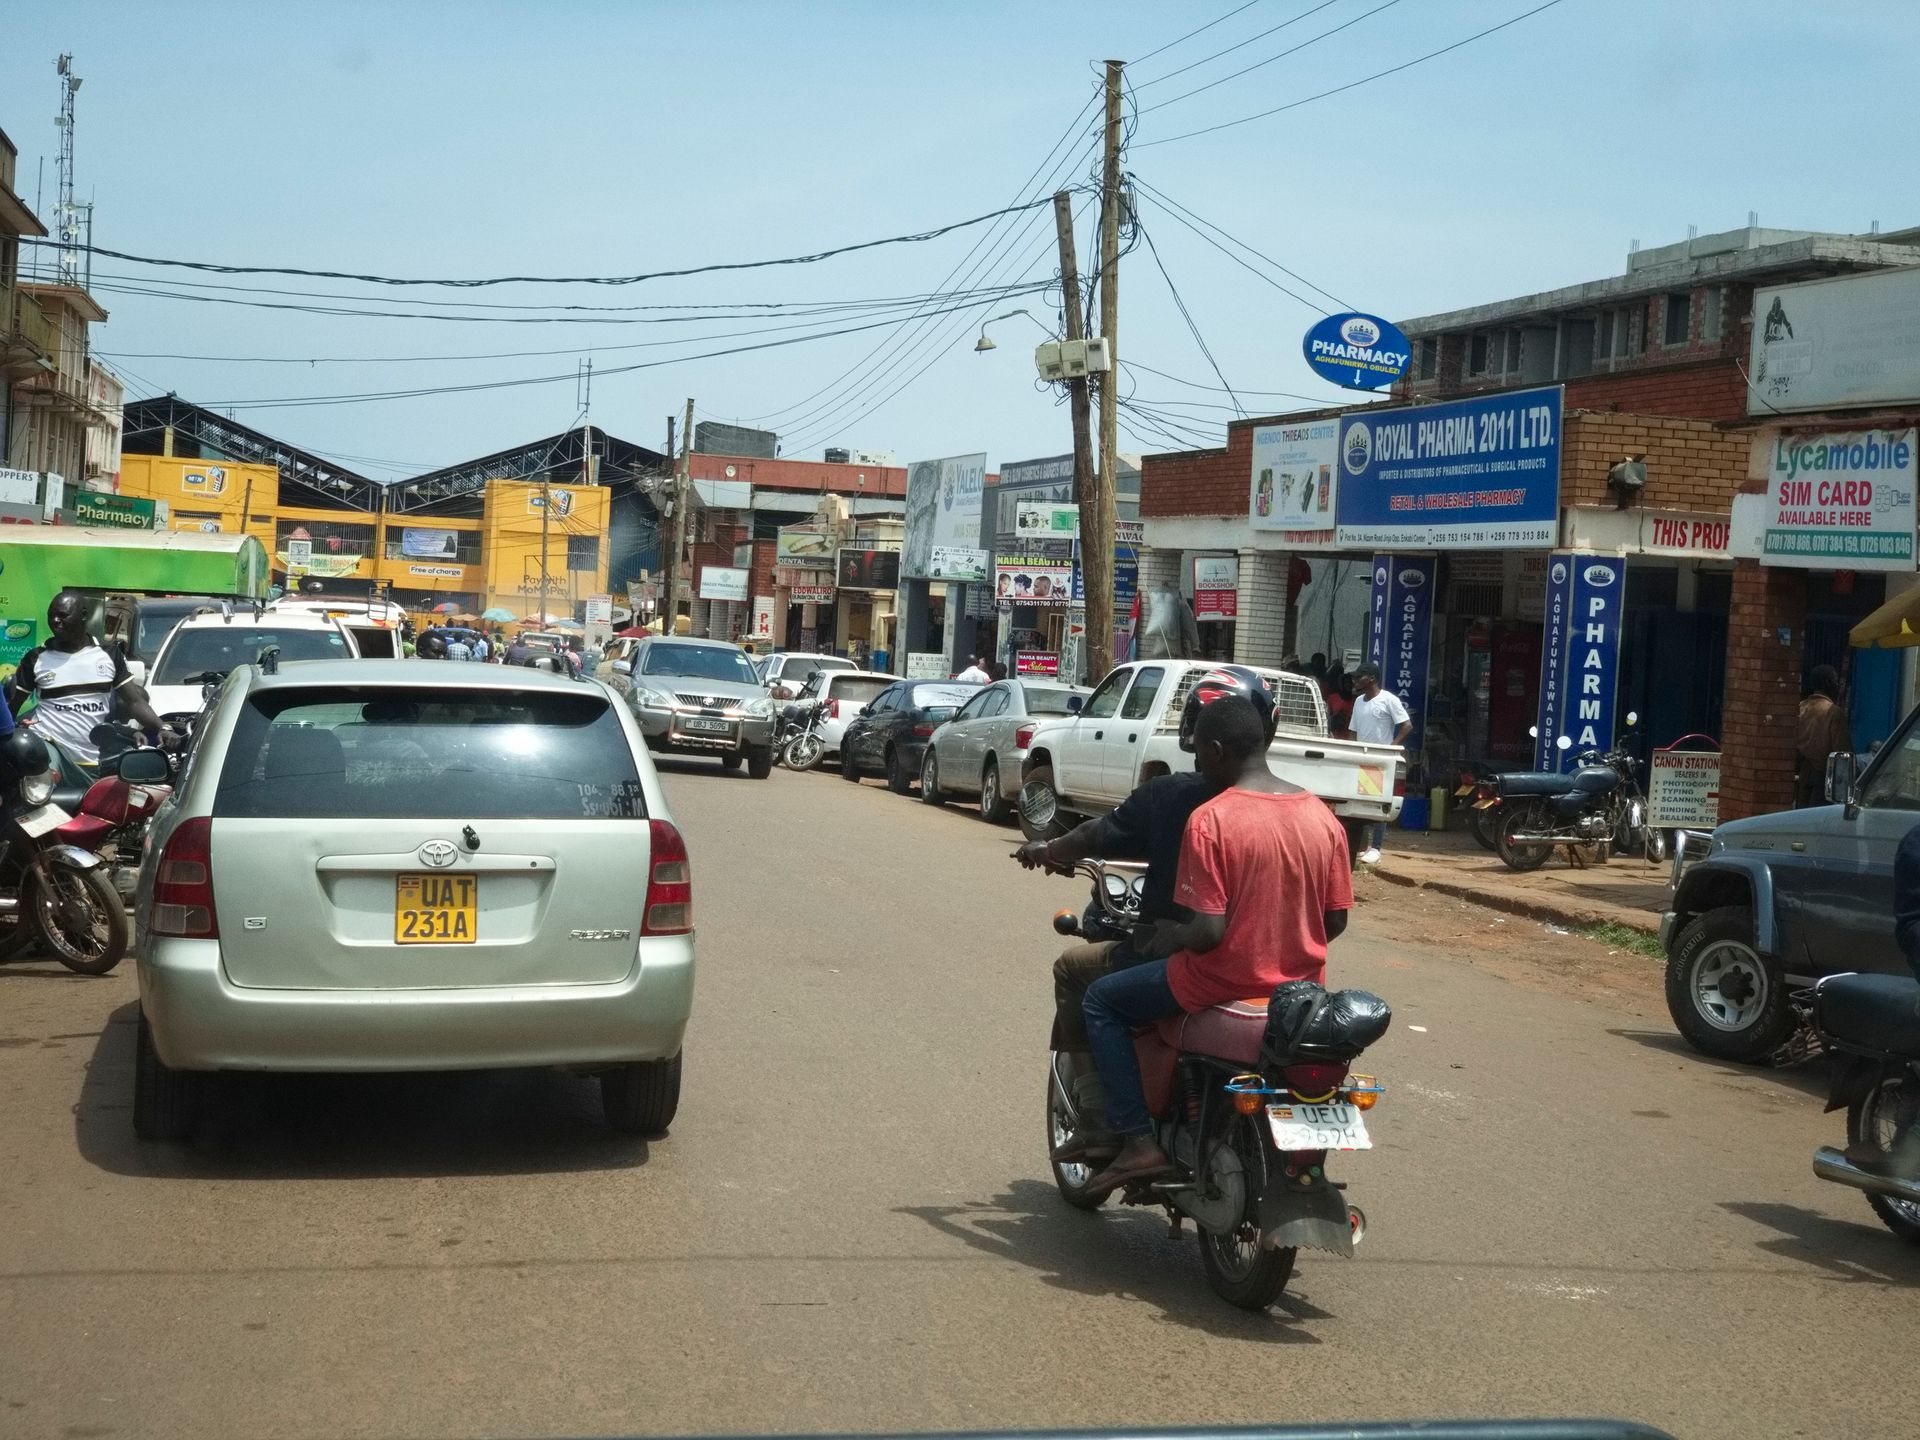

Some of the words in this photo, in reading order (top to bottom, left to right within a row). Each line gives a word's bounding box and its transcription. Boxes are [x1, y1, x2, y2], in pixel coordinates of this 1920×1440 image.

[1311, 339, 1408, 368] PHARMACY
[1314, 354, 1368, 370] AGHAFUNIRWA
[1369, 363, 1401, 375] OBULEZI
[1282, 427, 1309, 443] THREADS
[1310, 425, 1335, 440] CENTRE
[1375, 422, 1414, 462] ROYAL
[1417, 415, 1475, 459] PHARMA
[1478, 409, 1515, 453] 2011
[1519, 405, 1554, 449] LTD.
[1775, 434, 1910, 480] Lycamobile
[1378, 469, 1399, 481] IMPORTER
[1403, 467, 1435, 480] DISTRIBUTORS
[1435, 467, 1442, 478] OF
[1442, 463, 1484, 477] PHARMACEUTICAL
[1490, 460, 1516, 473] SURGICAL
[1517, 457, 1546, 471] PRODUCTS
[956, 463, 985, 495] YALELO
[1390, 495, 1416, 511] RETAIL
[1417, 495, 1424, 510] &
[1424, 491, 1473, 510] WHOLESALE
[1474, 487, 1527, 508] PHARMACY
[1778, 481, 1811, 506] SIM
[1817, 480, 1872, 507] CARD
[76, 503, 150, 529] Pharmacy
[1776, 511, 1836, 526] AVAILABLE
[1840, 511, 1872, 527] HERE
[1432, 533, 1446, 542] +256
[1448, 533, 1458, 542] 753
[1460, 532, 1471, 542] 154
[1490, 531, 1506, 541] +256
[1508, 531, 1520, 541] 779
[1522, 531, 1534, 541] 313
[1536, 530, 1549, 540] 884
[1653, 518, 1688, 548] THIS
[1766, 533, 1783, 550] 0701
[1783, 533, 1796, 551] 789
[1829, 535, 1843, 551] 384
[1895, 537, 1911, 554] 846
[779, 557, 806, 565] DENTAL
[997, 556, 1025, 566] NAIGA
[1026, 556, 1061, 567] BEAUTY
[436, 568, 461, 577] charge
[523, 574, 542, 585] Pay
[793, 586, 832, 595] EDDWALIRO
[1373, 594, 1383, 667] PHA
[0, 646, 32, 655] MANGO
[1396, 594, 1416, 697] AGHAFUNIRWA
[1547, 593, 1561, 712] AGHAFUNIRWA
[1027, 660, 1047, 671] Salon
[693, 719, 707, 728] UBJ
[1654, 755, 1683, 769] CANON
[1684, 757, 1720, 770] STATION
[1661, 796, 1707, 804] SCANNING
[1659, 806, 1697, 814] BINDING
[1659, 814, 1696, 822] SEALING
[421, 878, 473, 908] UAT
[402, 910, 469, 939] 231A
[568, 928, 631, 941] FIELDER
[1301, 1106, 1350, 1124] UEU
